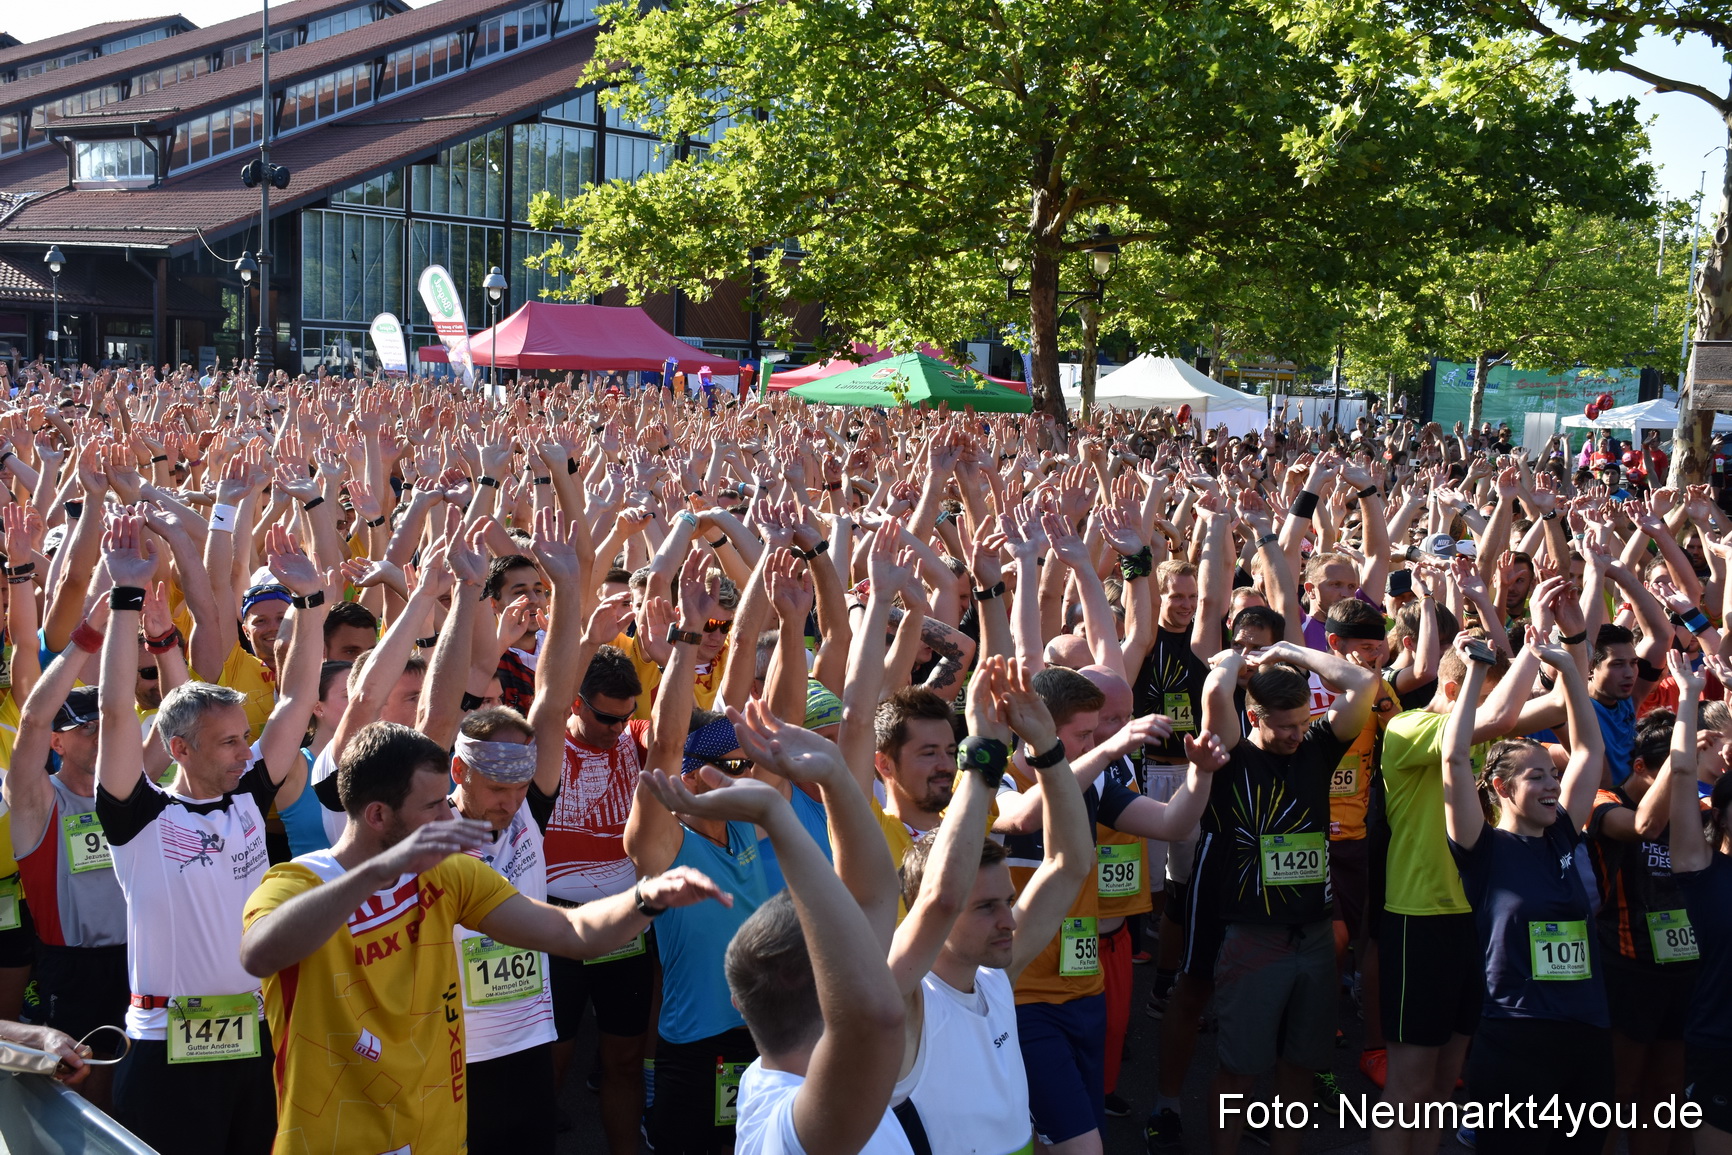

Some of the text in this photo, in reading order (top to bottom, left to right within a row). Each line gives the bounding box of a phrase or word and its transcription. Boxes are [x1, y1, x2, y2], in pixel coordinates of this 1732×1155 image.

[1457, 379, 1500, 390] firmauf
[1516, 376, 1619, 390] Gesunde Firmn
[1539, 388, 1577, 400] laufen
[1330, 770, 1353, 785] 56
[1270, 850, 1318, 870] 1420
[1102, 862, 1134, 882] 598
[1665, 927, 1697, 947] 805
[1075, 938, 1097, 960] 558
[1542, 941, 1586, 963] 1078
[476, 952, 536, 984] 1462
[491, 981, 518, 991] Hampel
[180, 1016, 243, 1043] 1471
[210, 1042, 240, 1050] Andreas
